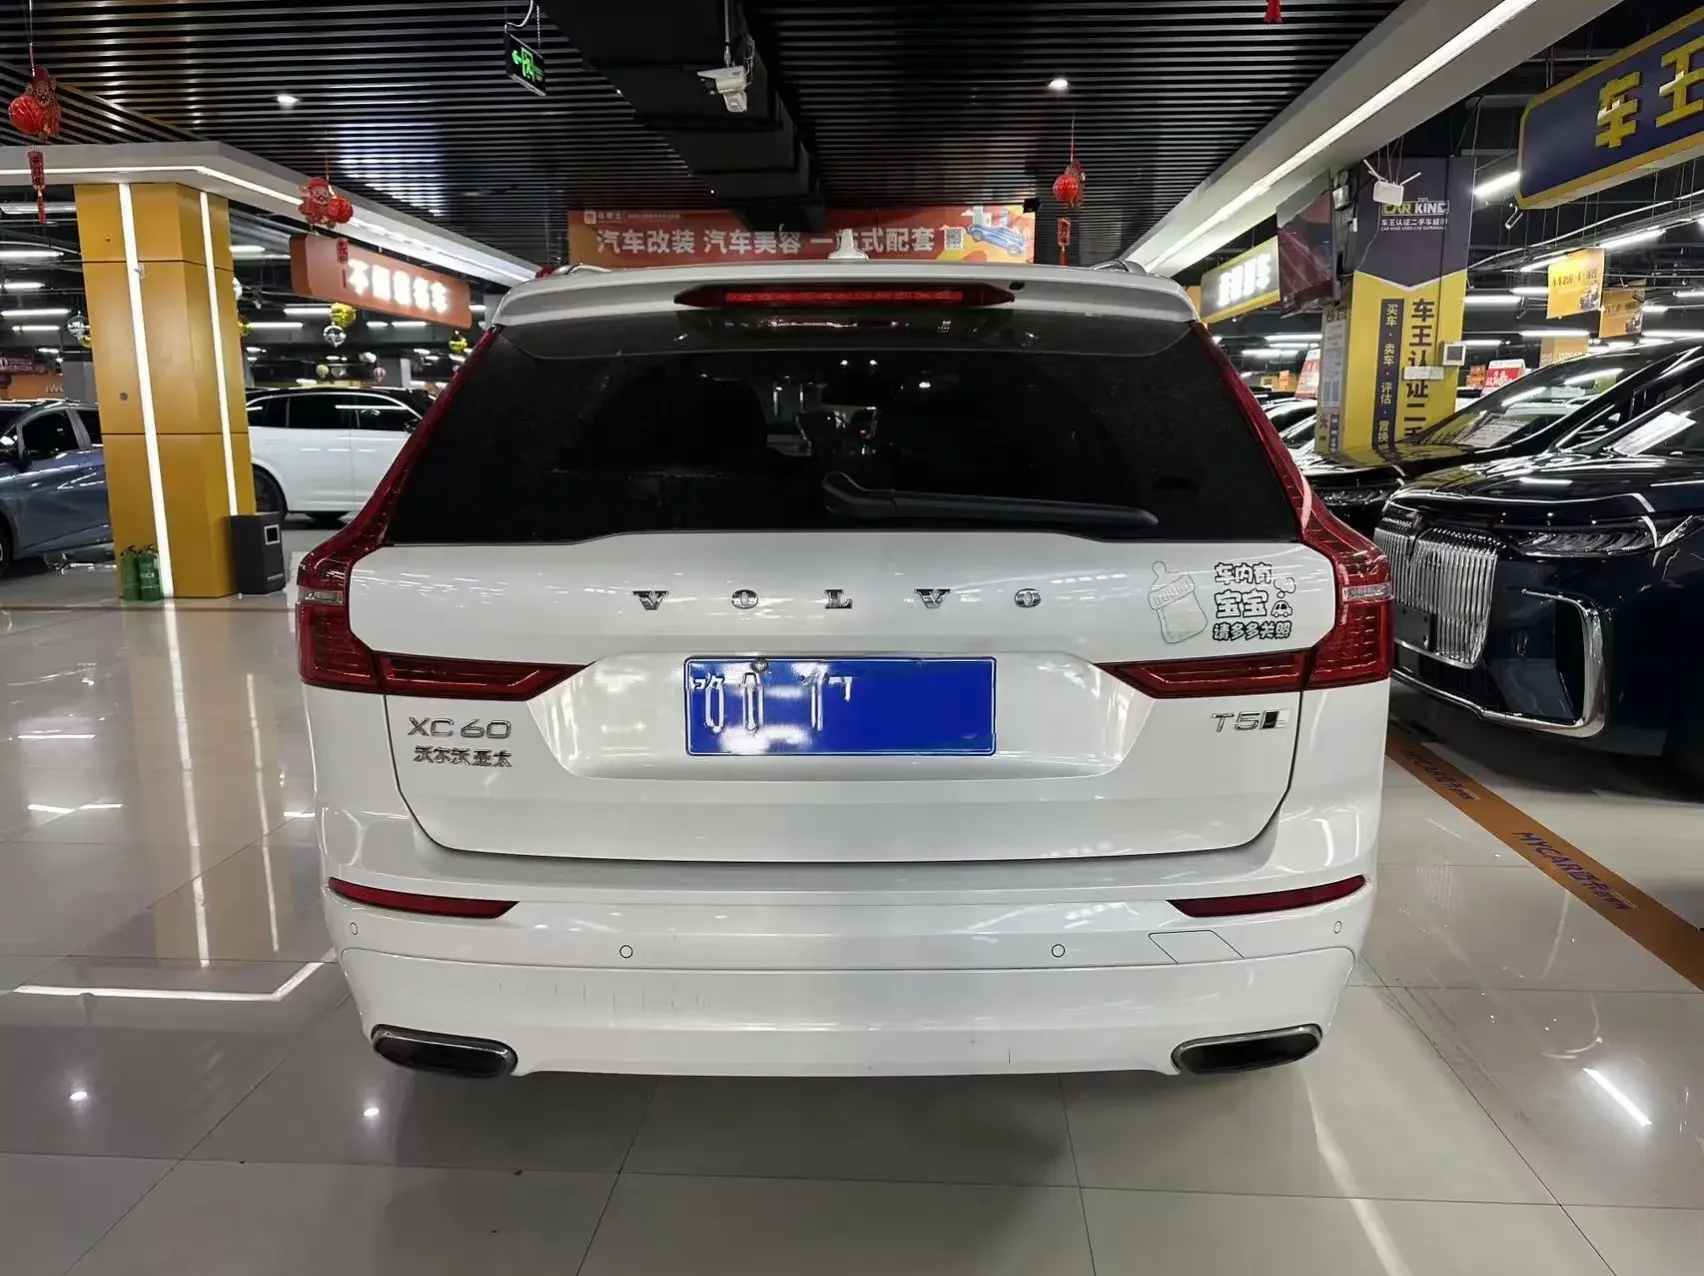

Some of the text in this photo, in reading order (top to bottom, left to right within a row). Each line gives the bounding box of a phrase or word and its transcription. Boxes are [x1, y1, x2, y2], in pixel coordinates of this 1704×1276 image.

[597, 229, 696, 254] 汽车改装
[703, 228, 801, 254] 汽车美容
[1213, 561, 1273, 585] 车内有
[632, 588, 1042, 611] VOLVO
[1213, 589, 1269, 618] 宝宝
[1212, 620, 1292, 641] 请多多关照
[407, 716, 512, 739] XC60
[1211, 710, 1260, 732] T5
[413, 745, 513, 768] 沃尔沃亚太
